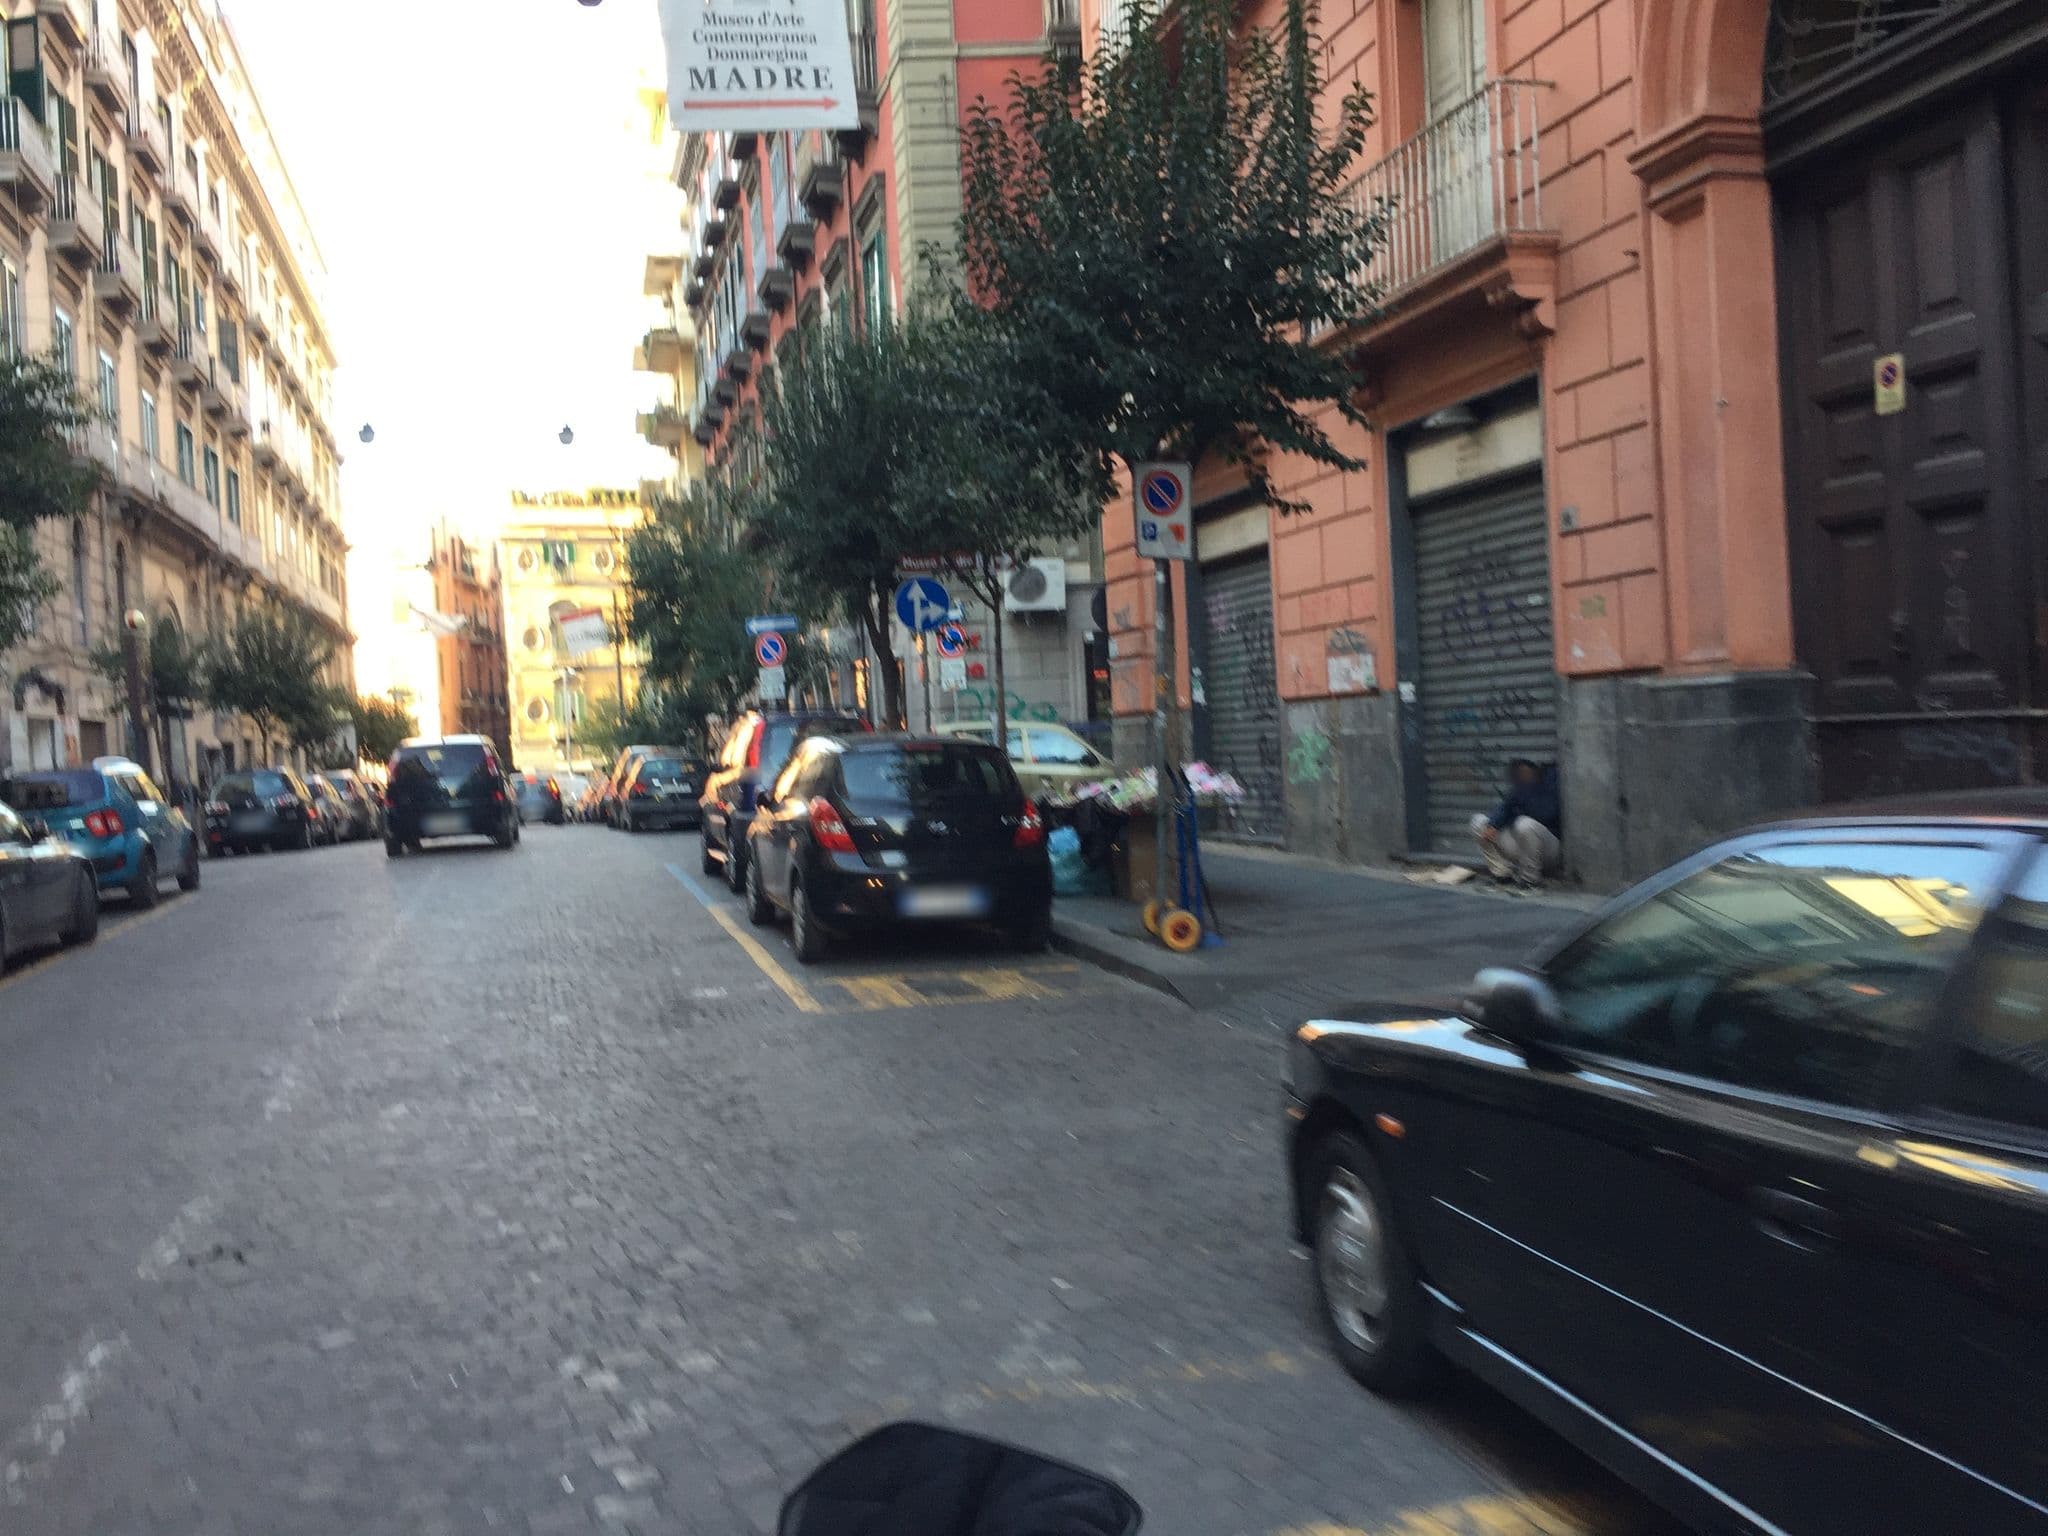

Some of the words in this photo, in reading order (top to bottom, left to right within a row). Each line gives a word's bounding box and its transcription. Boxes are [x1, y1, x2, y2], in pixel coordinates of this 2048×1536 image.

[702, 12, 754, 26] Museo
[758, 10, 804, 26] d'Arte
[692, 29, 817, 46] Contemporanea
[707, 47, 808, 63] Donnaregina
[689, 66, 833, 91] MADRE
